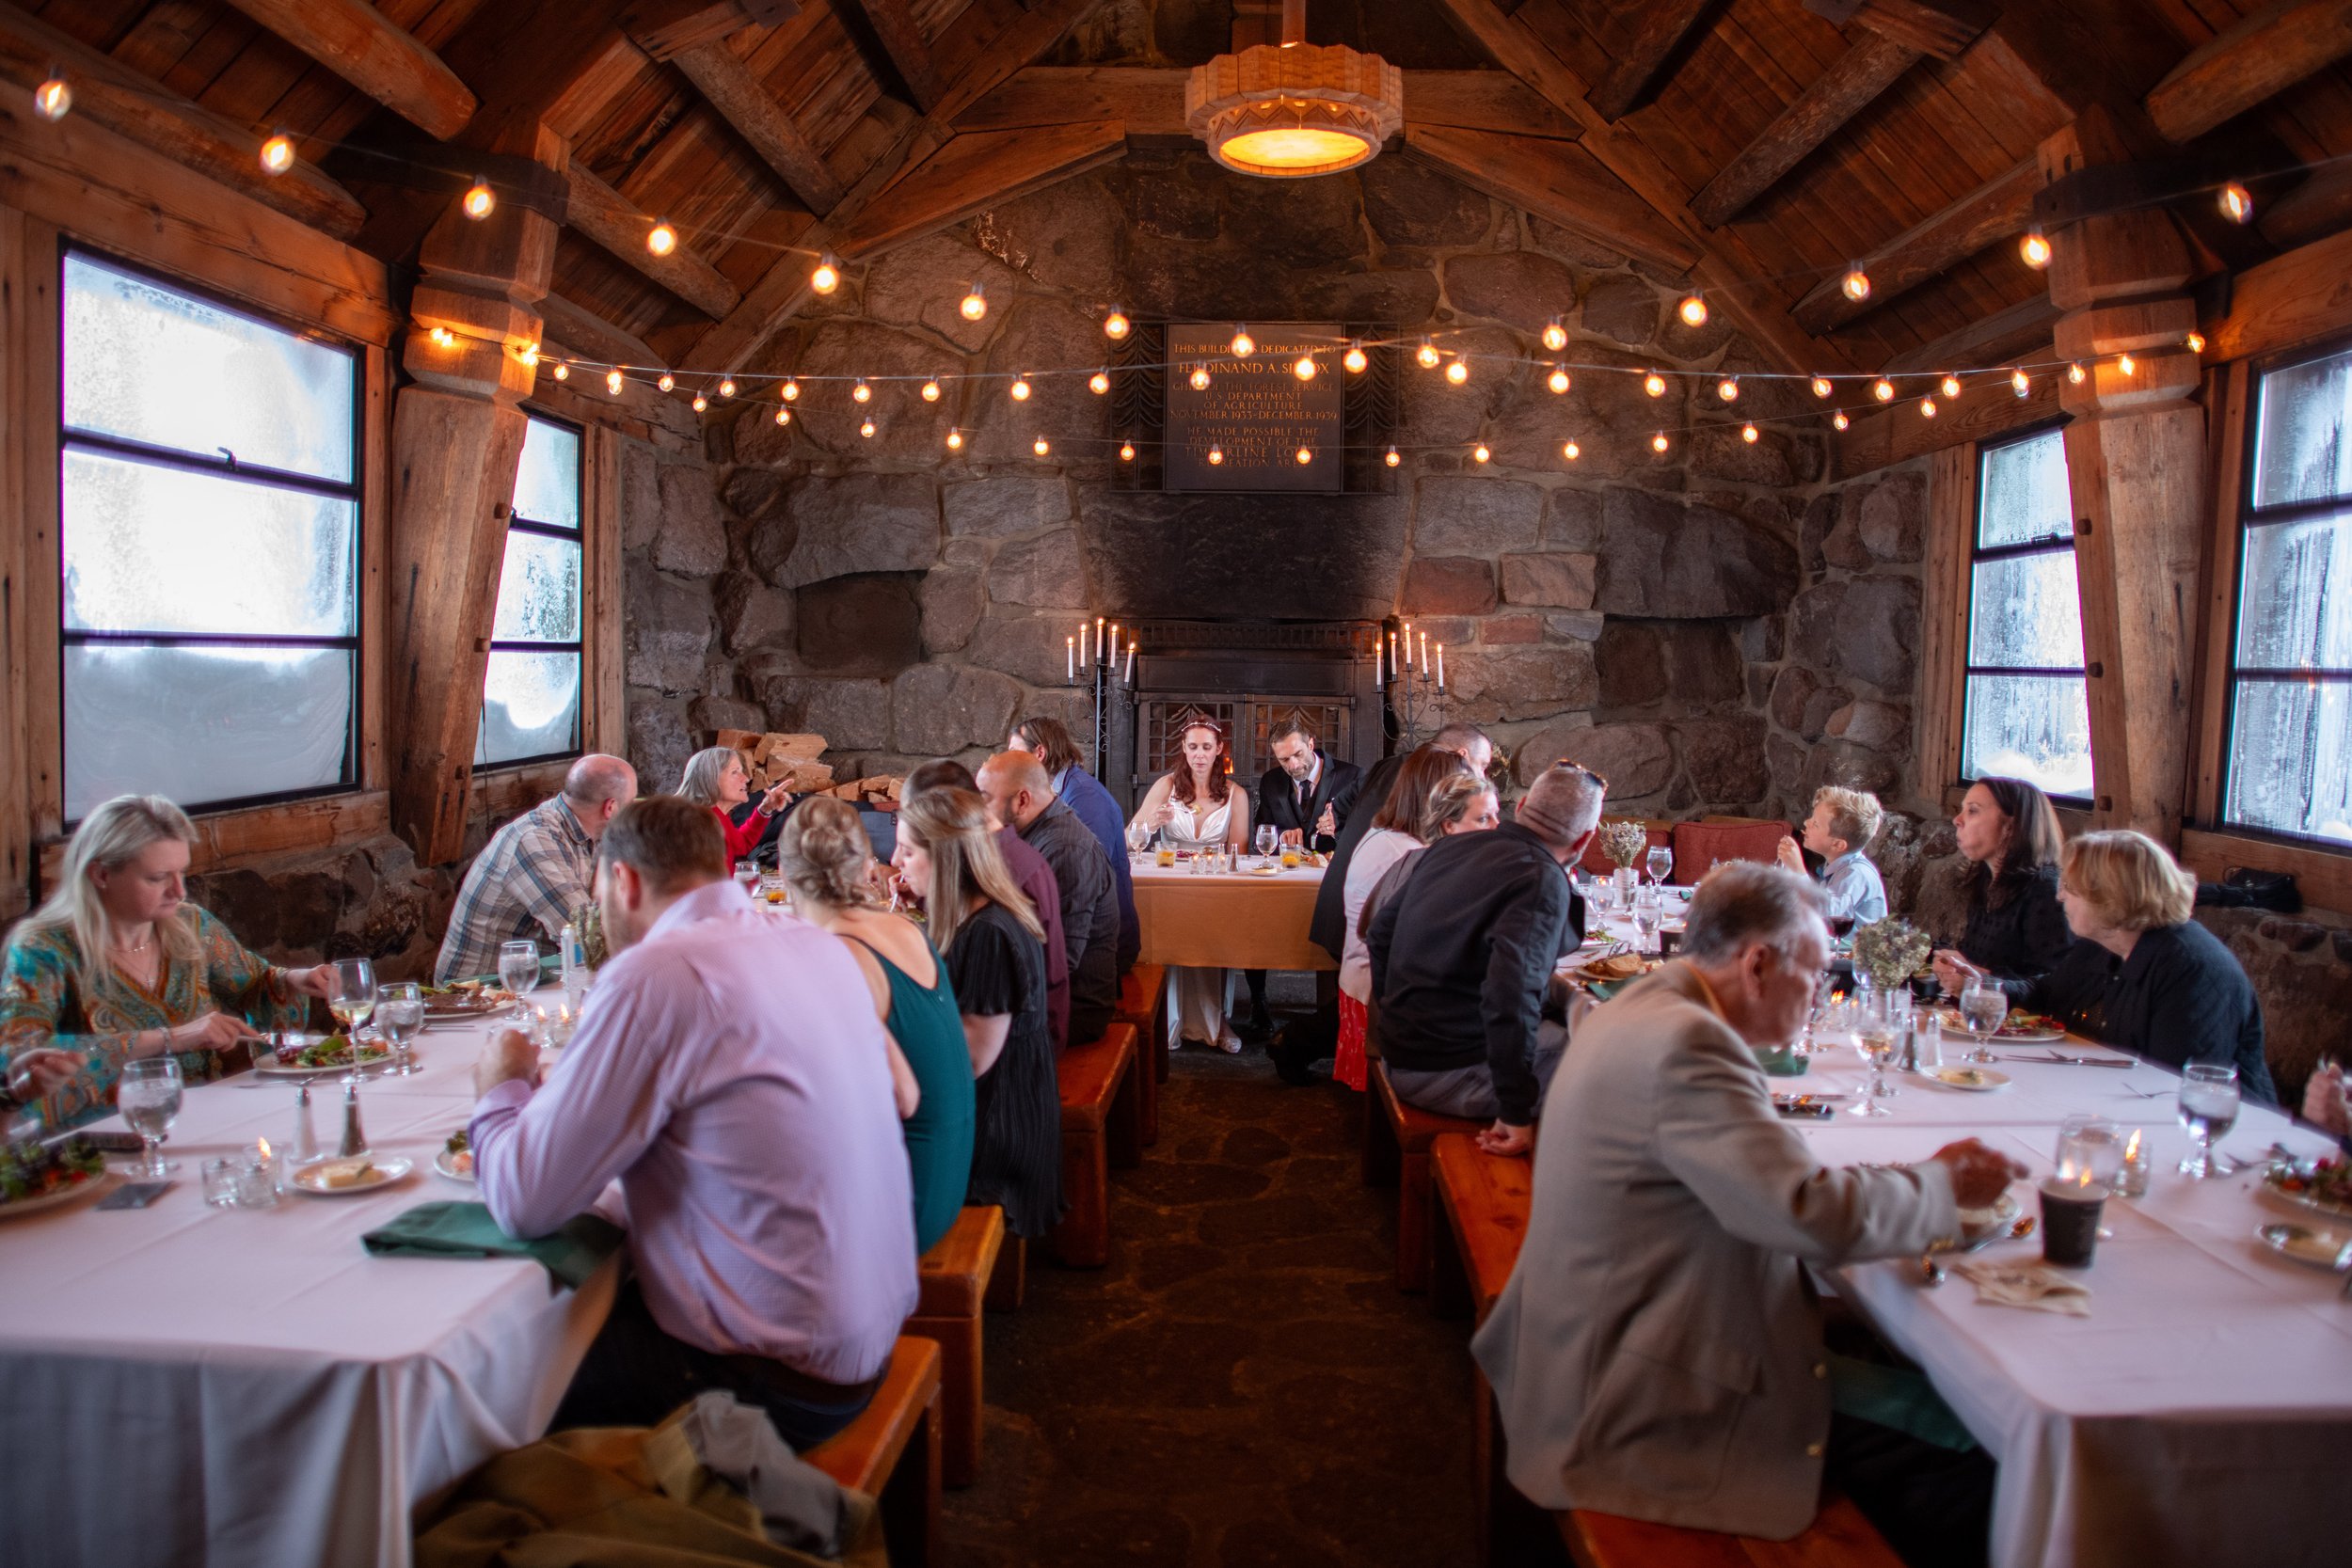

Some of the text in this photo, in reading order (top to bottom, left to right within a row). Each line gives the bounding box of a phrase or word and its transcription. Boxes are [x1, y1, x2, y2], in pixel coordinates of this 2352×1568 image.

[1173, 344, 1196, 354] THIS
[1199, 344, 1247, 354] BUILDI
[1321, 344, 1336, 354] TO
[1266, 363, 1279, 374] A.
[1249, 383, 1287, 392] FOREST
[1292, 383, 1334, 392] SERVICE
[1228, 392, 1301, 401] DEPARTMENT
[1204, 401, 1303, 410] OF AGRICULTURE
[1170, 410, 1228, 420] NOVEMBER
[1316, 411, 1337, 421] 1939
[1188, 427, 1319, 436] HE MADE POSSIBLE THE
[1190, 437, 1316, 446] DEVELOPMENT OF THE
[1185, 447, 1320, 458] TIMRLINE LOE
[1278, 458, 1309, 467] ARE
